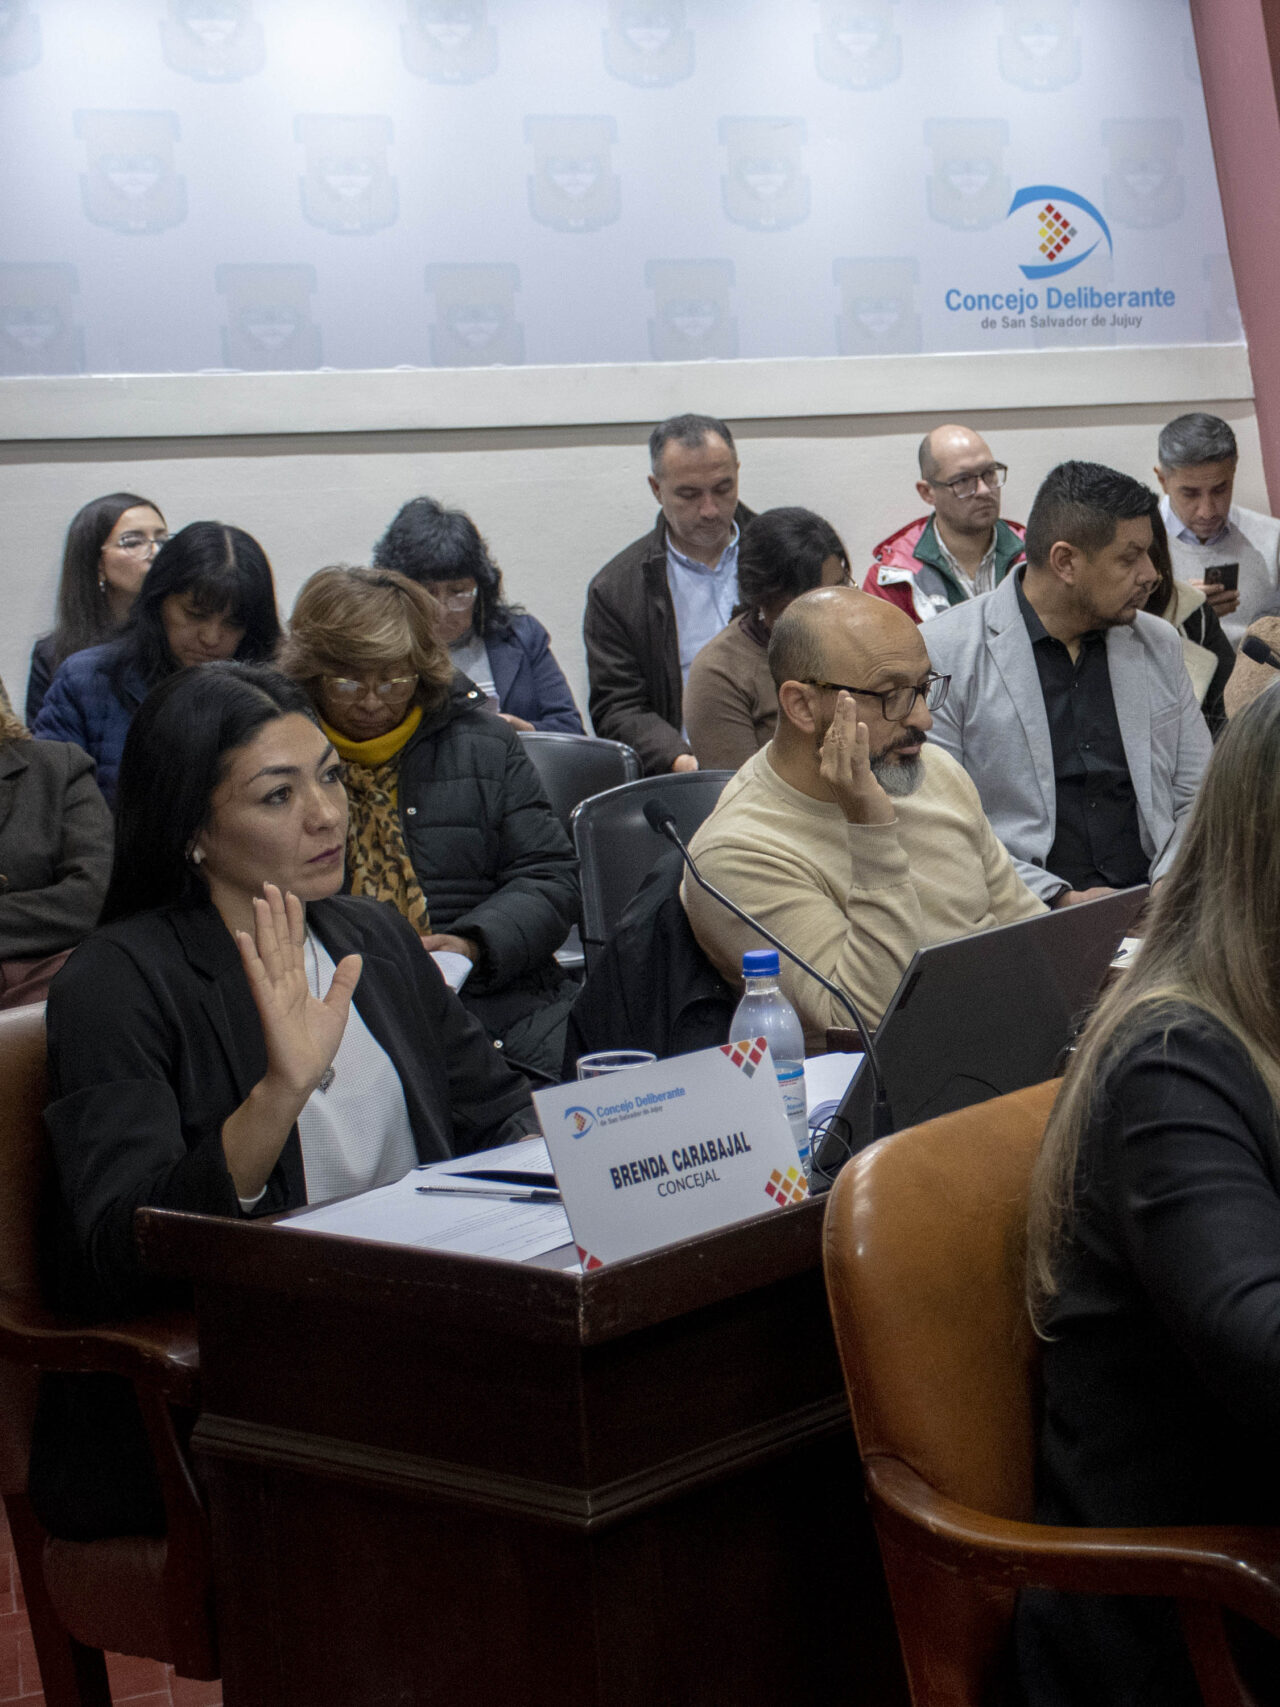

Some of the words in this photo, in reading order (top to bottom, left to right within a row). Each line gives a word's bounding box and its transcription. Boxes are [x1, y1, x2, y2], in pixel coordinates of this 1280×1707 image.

[945, 288, 1038, 314] Concejo
[1046, 287, 1175, 310] Deliberante
[981, 316, 997, 329] de
[1001, 316, 1026, 329] San
[1030, 315, 1087, 328] Salvador
[1091, 314, 1106, 327] de
[1110, 313, 1142, 329] Jujuy
[596, 1100, 634, 1117] Concejo
[635, 1087, 686, 1107] Deliberante
[610, 1154, 669, 1190] BRENDA
[671, 1131, 752, 1172] CARABAJAL
[657, 1168, 720, 1197] CONCEJAL
